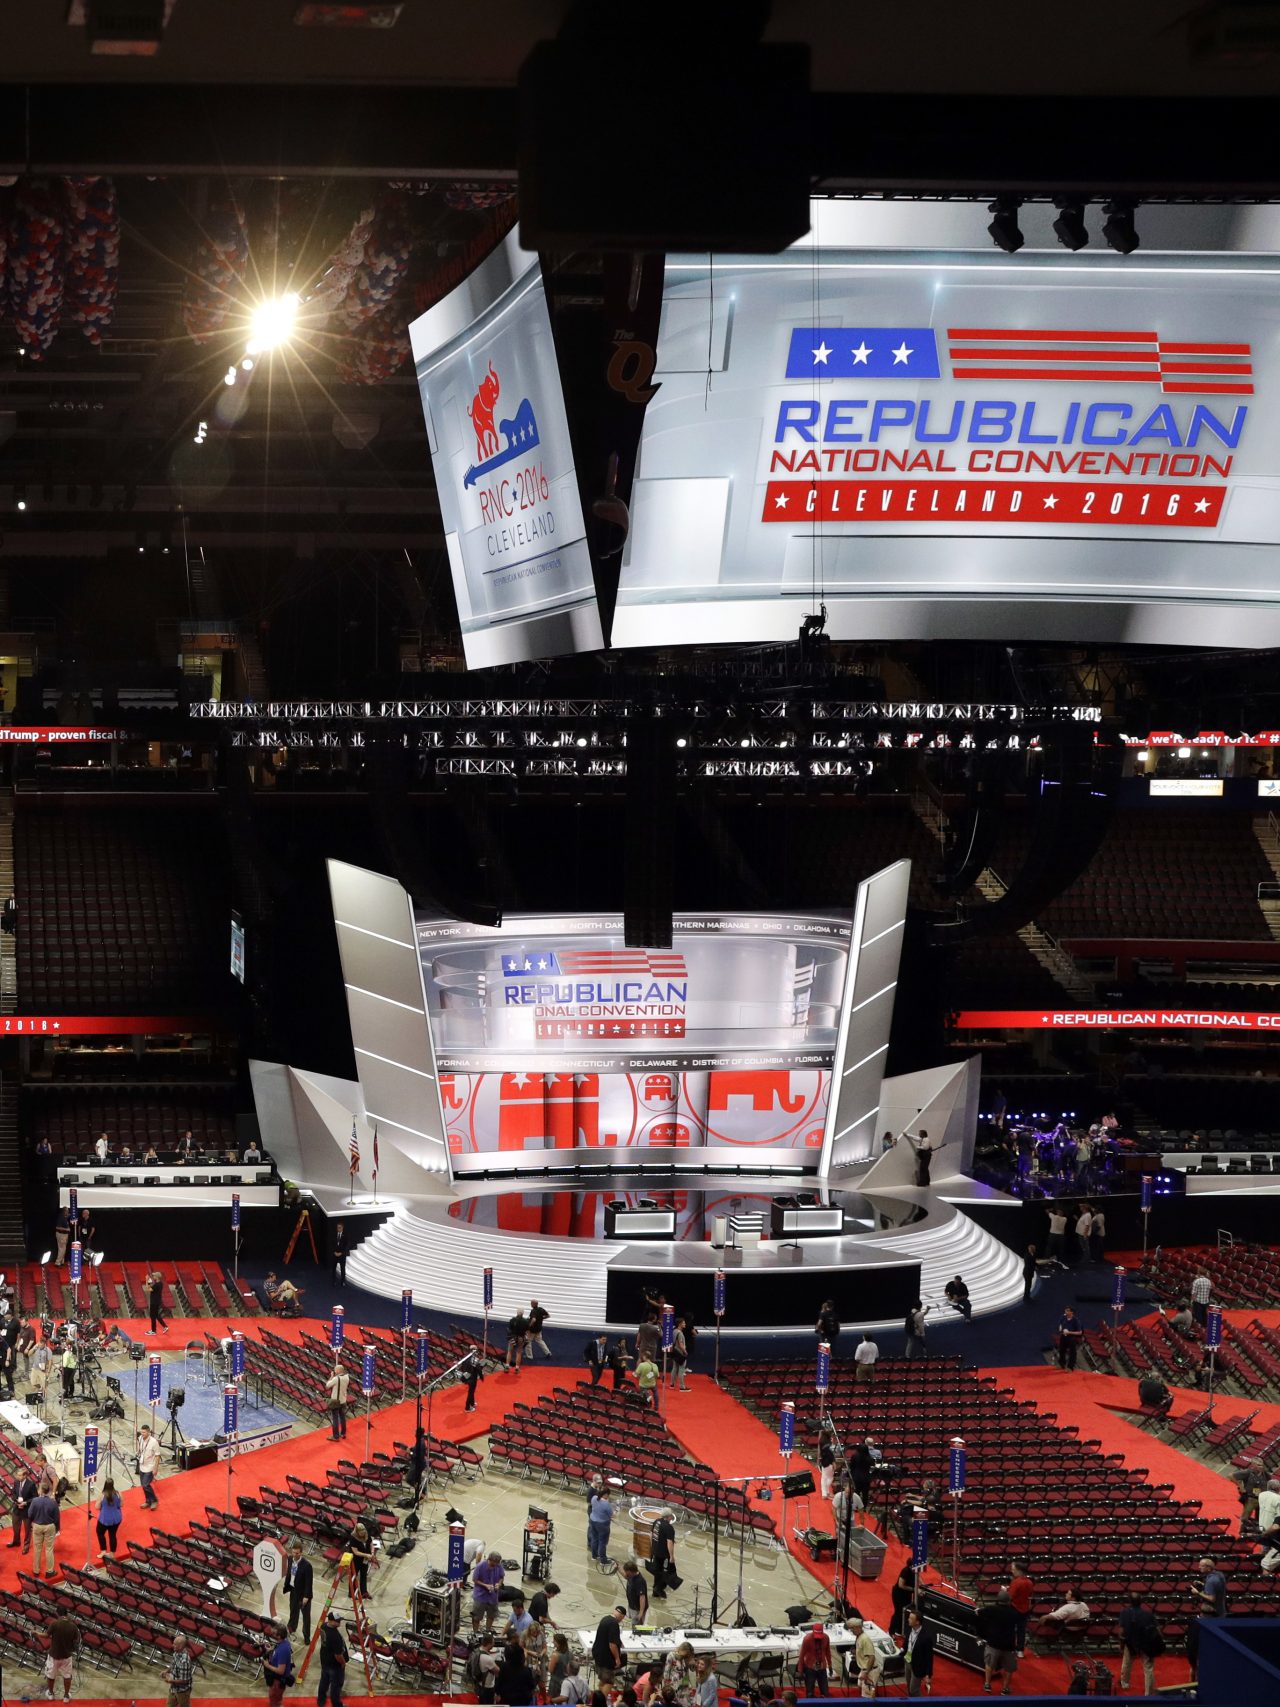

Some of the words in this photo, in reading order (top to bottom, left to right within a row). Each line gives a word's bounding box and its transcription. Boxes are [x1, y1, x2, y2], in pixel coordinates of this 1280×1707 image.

[607, 341, 662, 403] Q
[773, 399, 1247, 450] REPUBLICAN
[770, 449, 956, 474] NATIONAL
[967, 449, 1233, 479] CONVENTION
[479, 480, 514, 526] RNC
[516, 462, 549, 511] 2016
[805, 489, 1022, 513] CLEVELAND
[1081, 491, 1181, 516] 2016
[487, 511, 556, 556] CLEVELAND
[48, 732, 86, 742] proven
[89, 729, 117, 740] fiscal
[419, 929, 437, 938] NEW
[438, 928, 461, 936] YORK
[707, 922, 750, 930] MARIANAS
[793, 925, 831, 933] OKLAHOMA
[504, 982, 688, 1005] REPUBLICAN
[579, 1004, 686, 1016] CONVENTION
[5, 1020, 47, 1031] 2016
[1053, 1013, 1156, 1025] REPUBLICAN
[1161, 1013, 1252, 1026] NATIONAL
[538, 1024, 606, 1036] EVELAND
[630, 1023, 670, 1035] 2016
[437, 1059, 470, 1067] IFORNIA
[692, 1059, 729, 1067] DISTRICT
[744, 1057, 784, 1065] COLUMBIA
